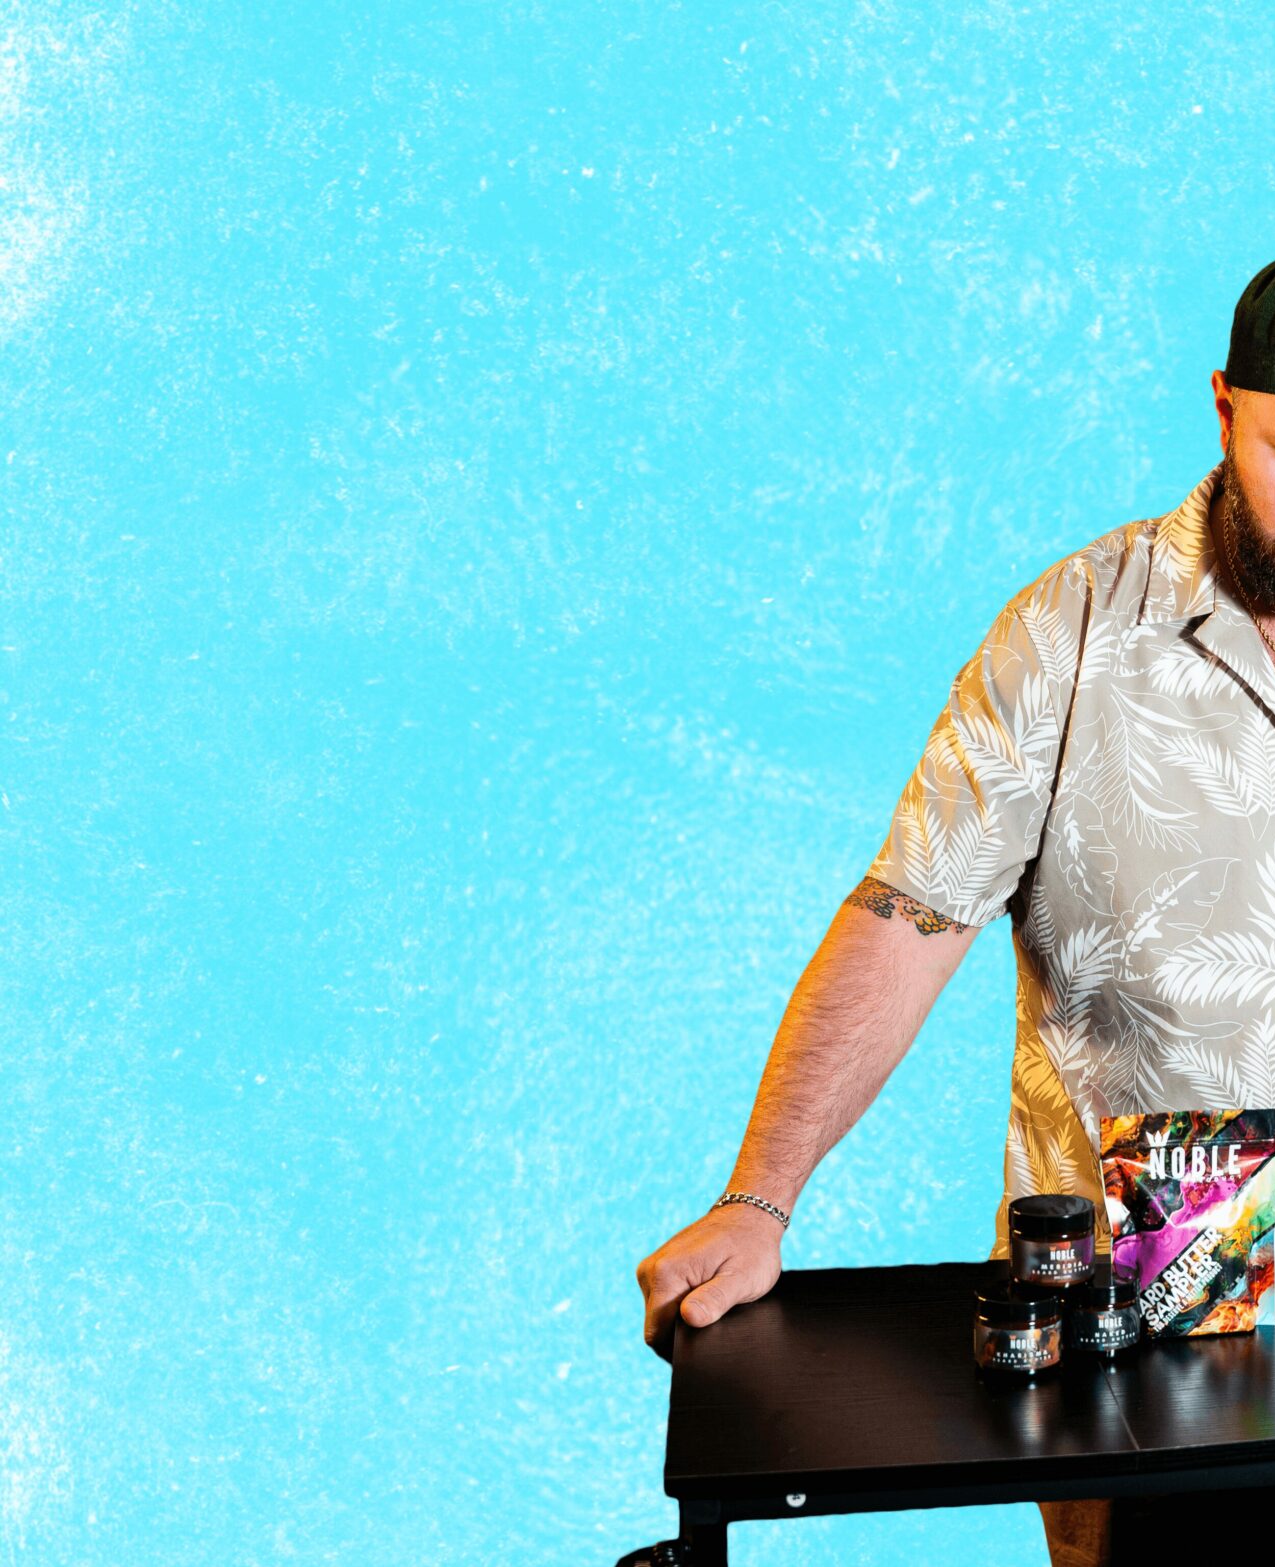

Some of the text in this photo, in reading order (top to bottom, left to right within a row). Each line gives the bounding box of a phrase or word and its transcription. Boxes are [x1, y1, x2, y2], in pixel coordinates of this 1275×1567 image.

[1150, 1144, 1242, 1180] NOBLE
[1050, 1249, 1075, 1260] NOBLE
[1140, 1226, 1223, 1318] ARD BUTTER
[1145, 1253, 1219, 1327] SAMPLER
[1099, 1317, 1123, 1328] NOBLE
[1010, 1339, 1036, 1349] NOBLE
